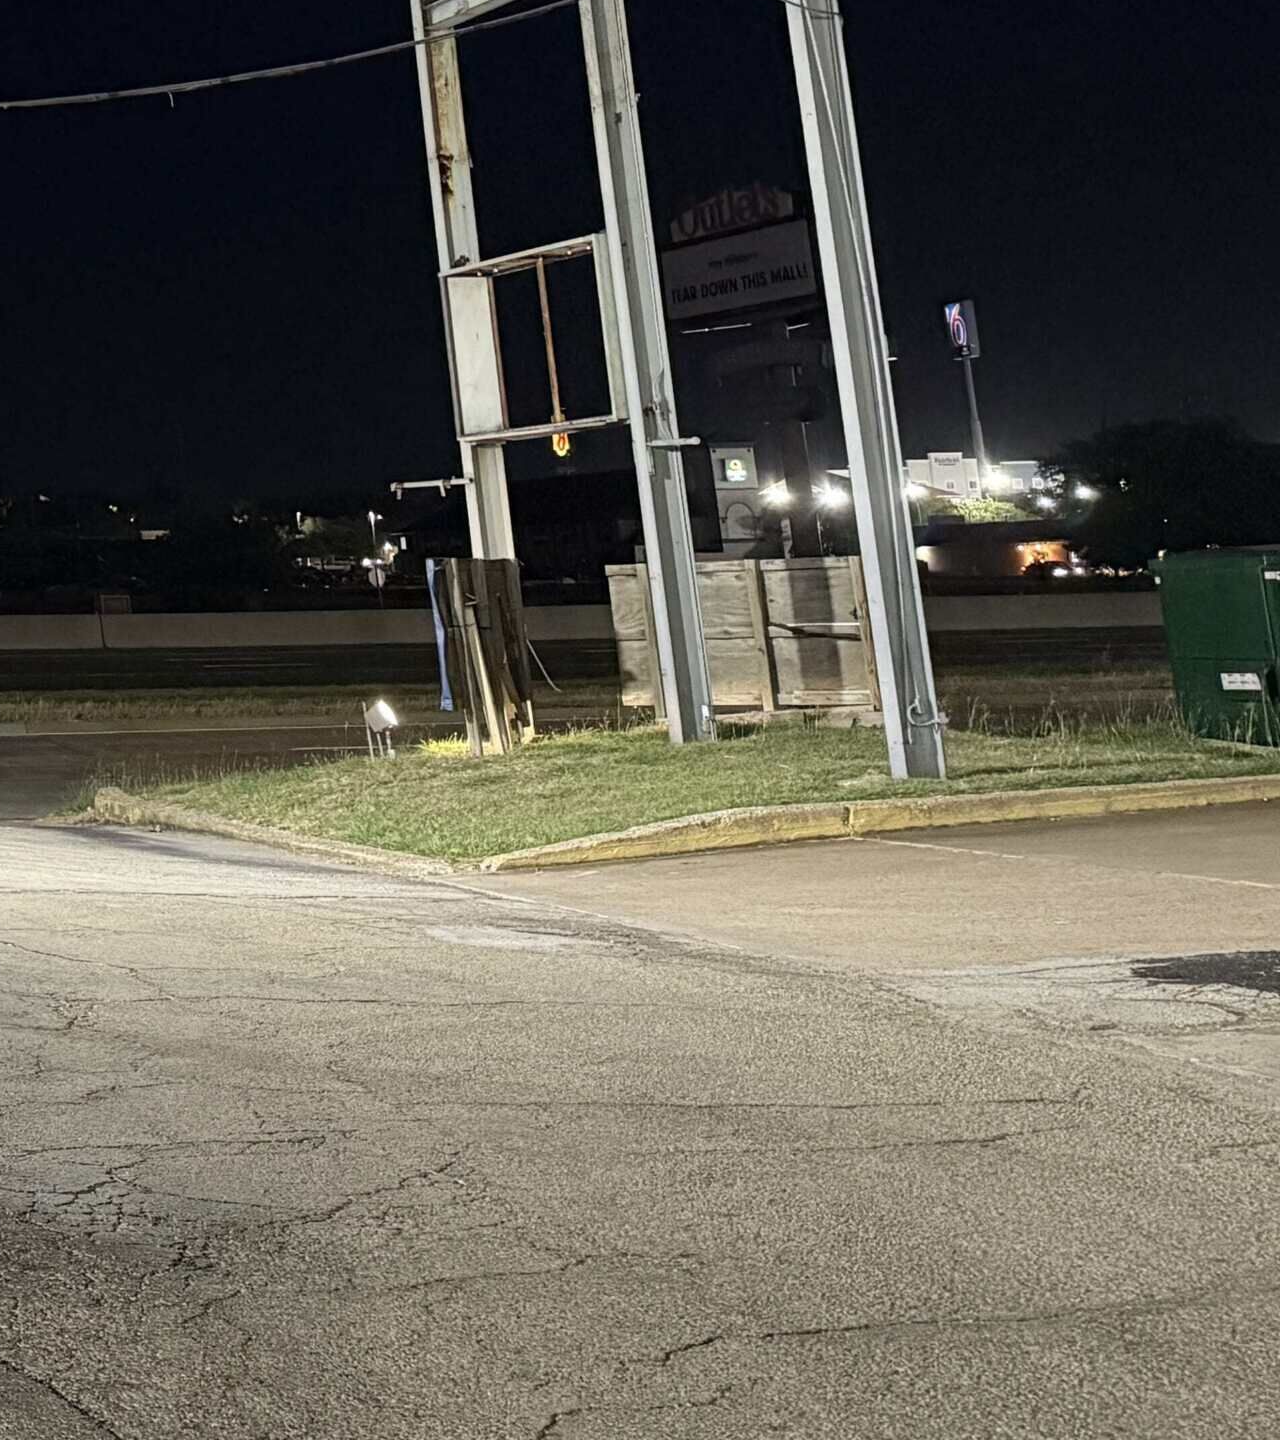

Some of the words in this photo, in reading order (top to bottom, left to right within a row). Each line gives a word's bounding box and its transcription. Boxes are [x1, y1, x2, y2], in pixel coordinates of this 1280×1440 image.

[671, 286, 697, 304] TEAR
[700, 277, 739, 298] DOWN
[740, 271, 768, 291] THIS
[770, 262, 808, 285] MALL!
